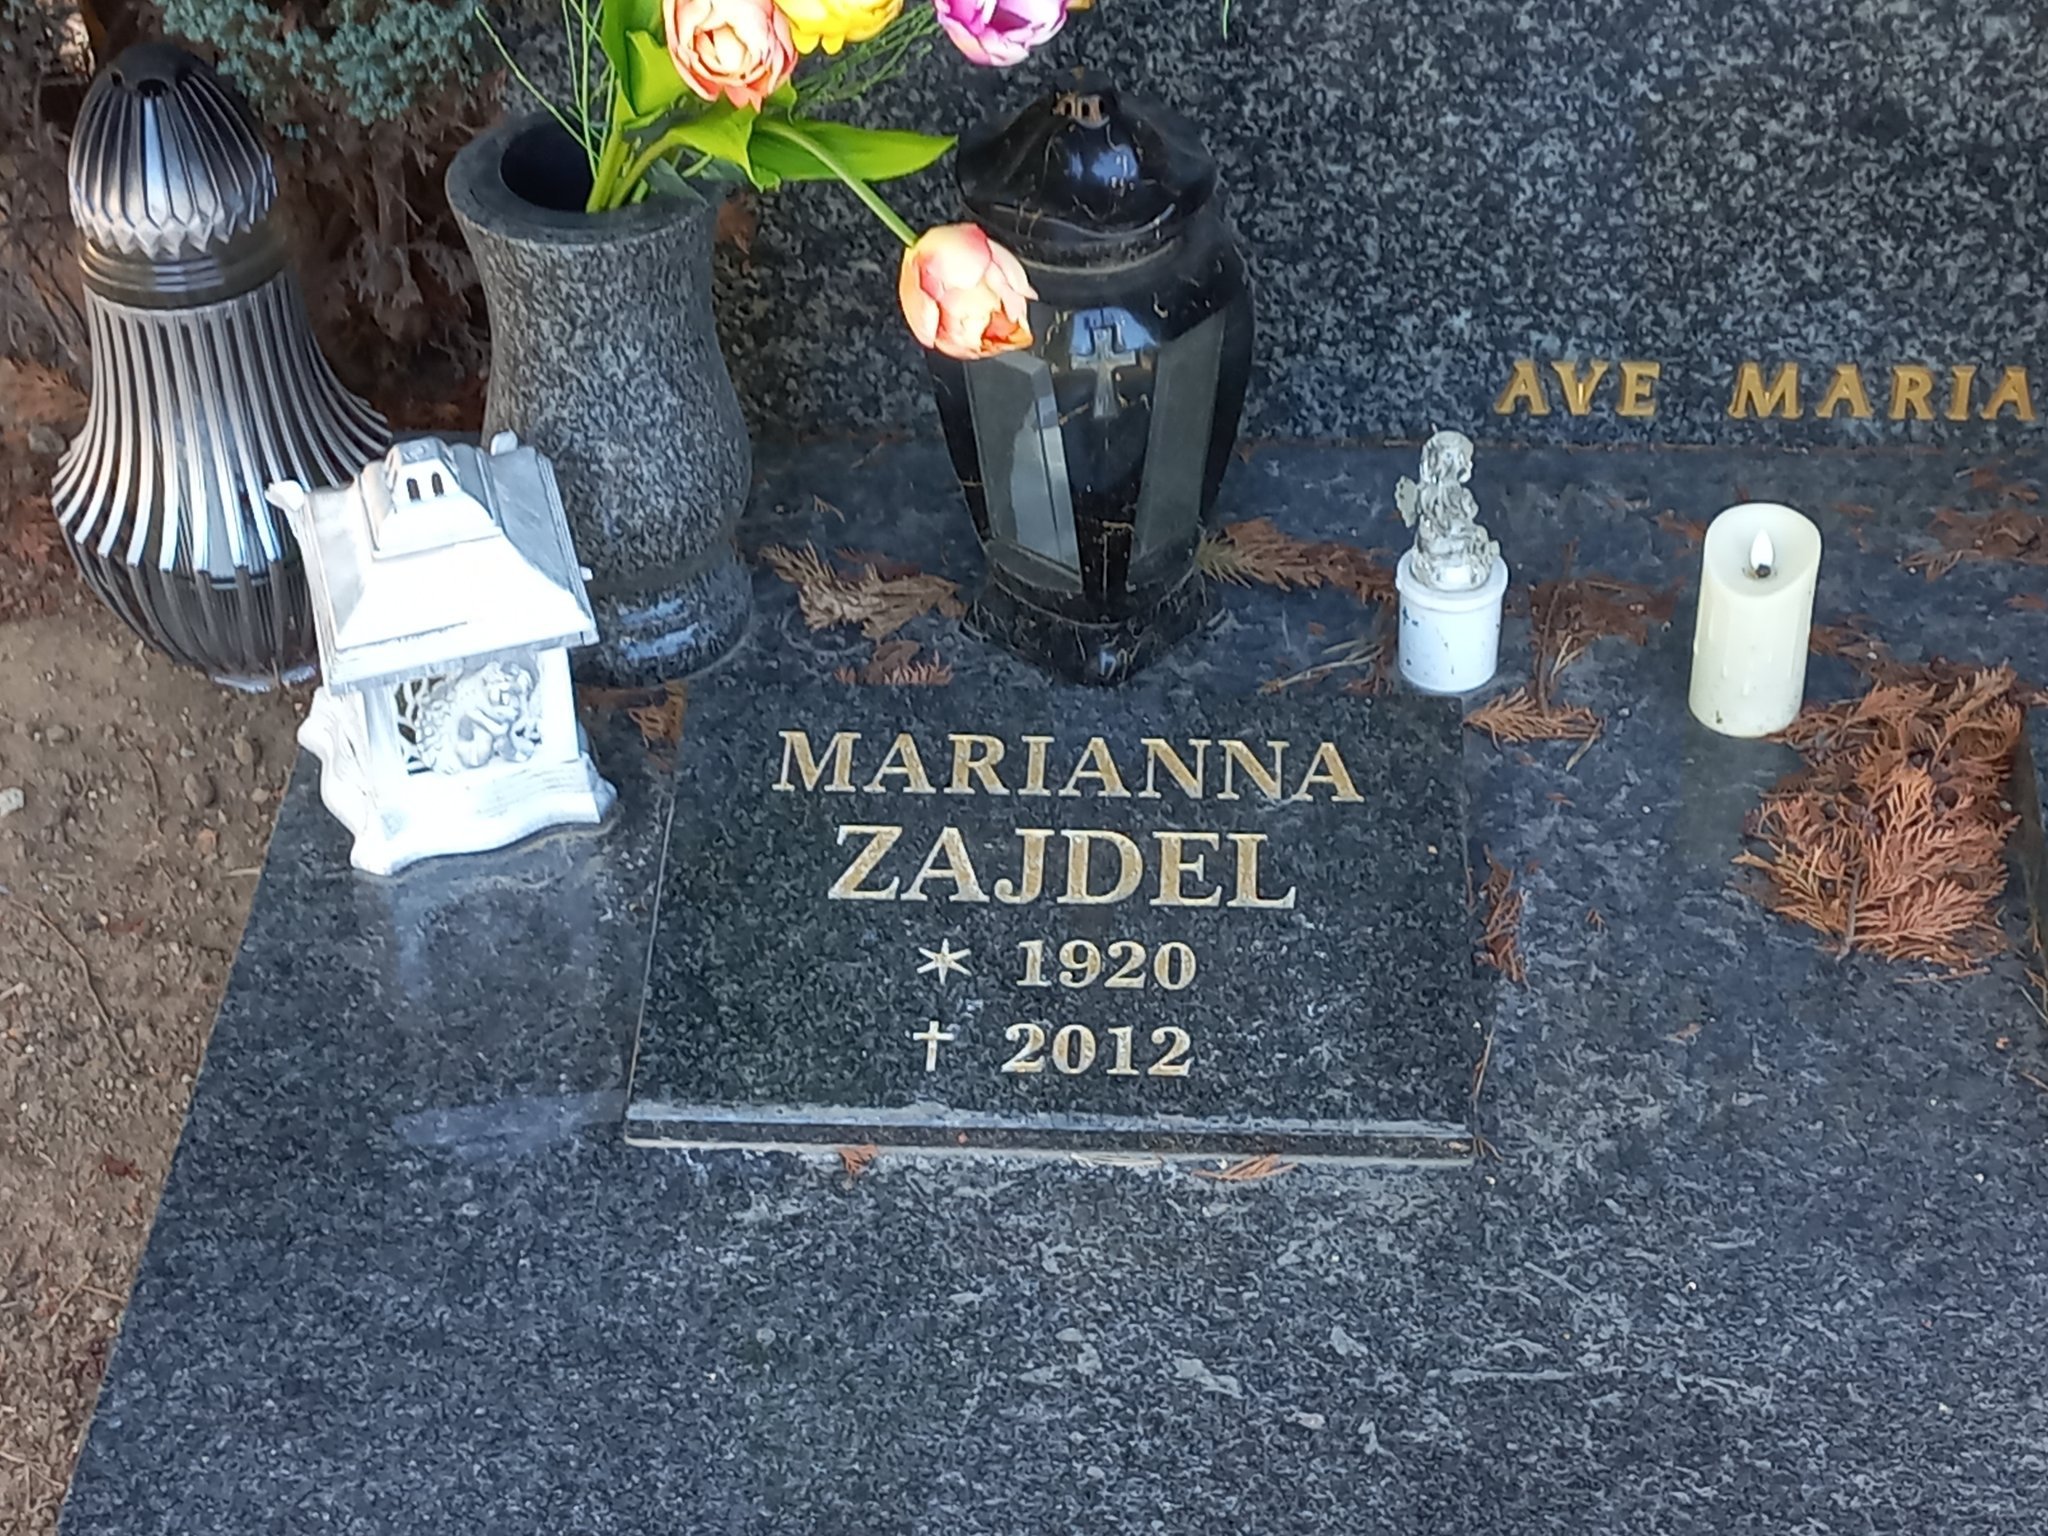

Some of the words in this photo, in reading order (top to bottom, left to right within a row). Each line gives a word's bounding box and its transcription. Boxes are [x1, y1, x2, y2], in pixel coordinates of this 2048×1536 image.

[1494, 360, 1661, 417] AVE
[1727, 361, 2037, 421] MARIA
[772, 730, 1364, 802] MARIANNA
[828, 824, 1296, 909] ZAJDEL
[1016, 939, 1197, 990] 1920
[1001, 1023, 1193, 1077] 2012
